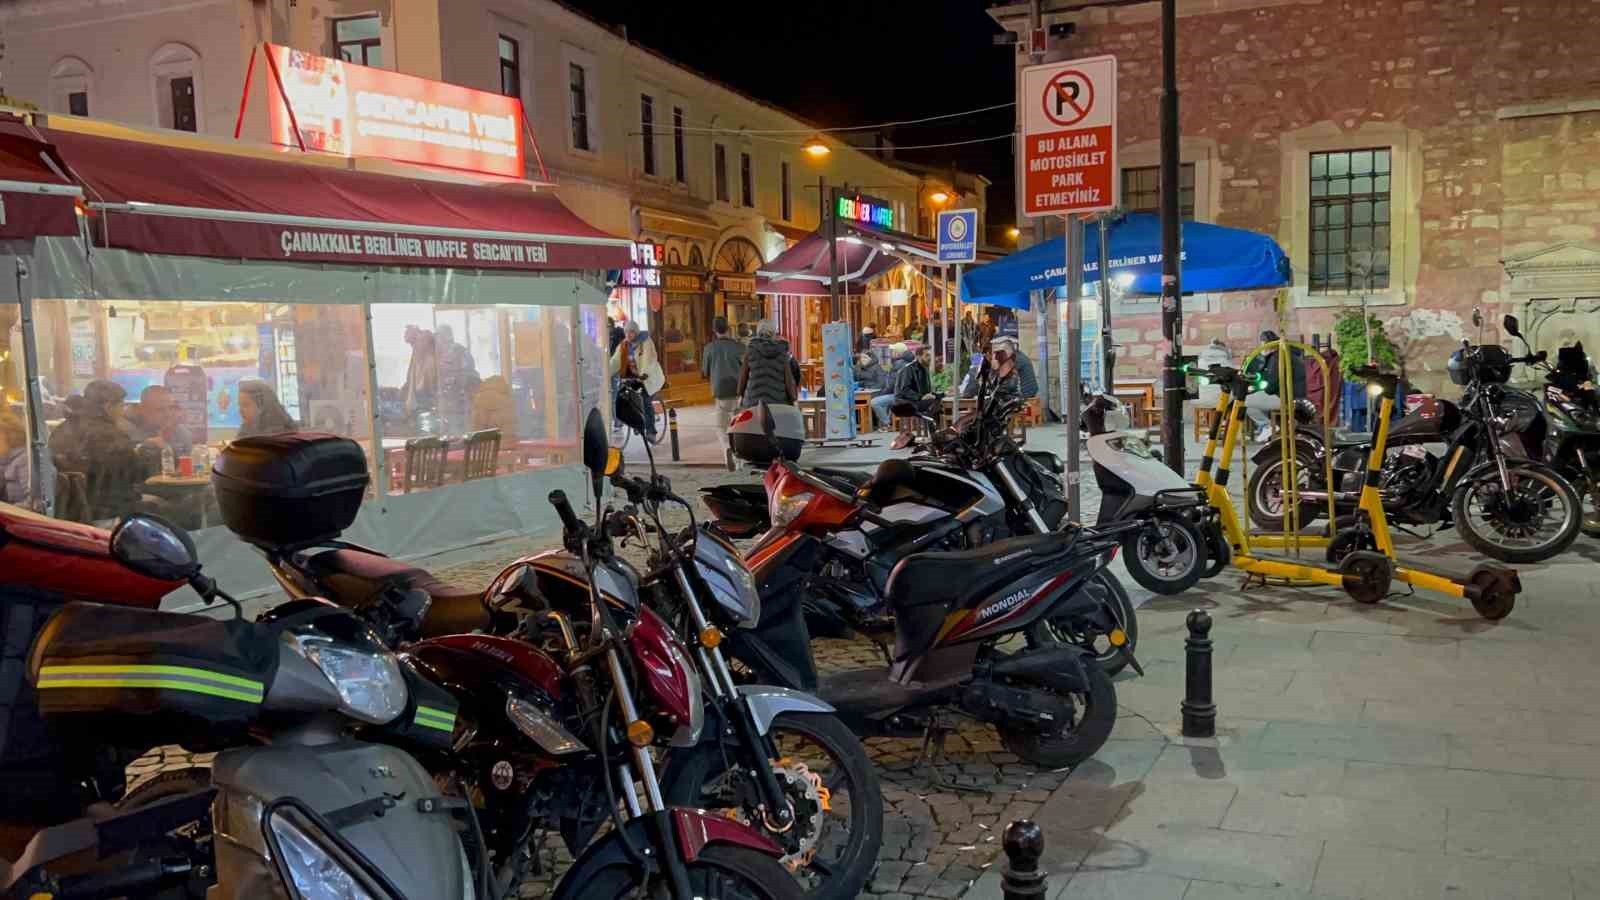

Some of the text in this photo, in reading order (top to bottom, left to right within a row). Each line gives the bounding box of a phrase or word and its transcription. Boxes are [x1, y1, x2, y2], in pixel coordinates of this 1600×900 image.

[1038, 134, 1098, 153] BU ALANA
[1030, 151, 1106, 172] MOTOSİKLET
[1052, 172, 1084, 187] PARK
[1035, 188, 1100, 207] ETMEYİNİZ
[281, 230, 362, 256] ÇANAKKALE
[364, 233, 423, 258] BERLİNER
[425, 239, 468, 258] WAFFLE
[1108, 254, 1146, 269] ERLİNER
[981, 588, 1032, 619] MONDIAL
